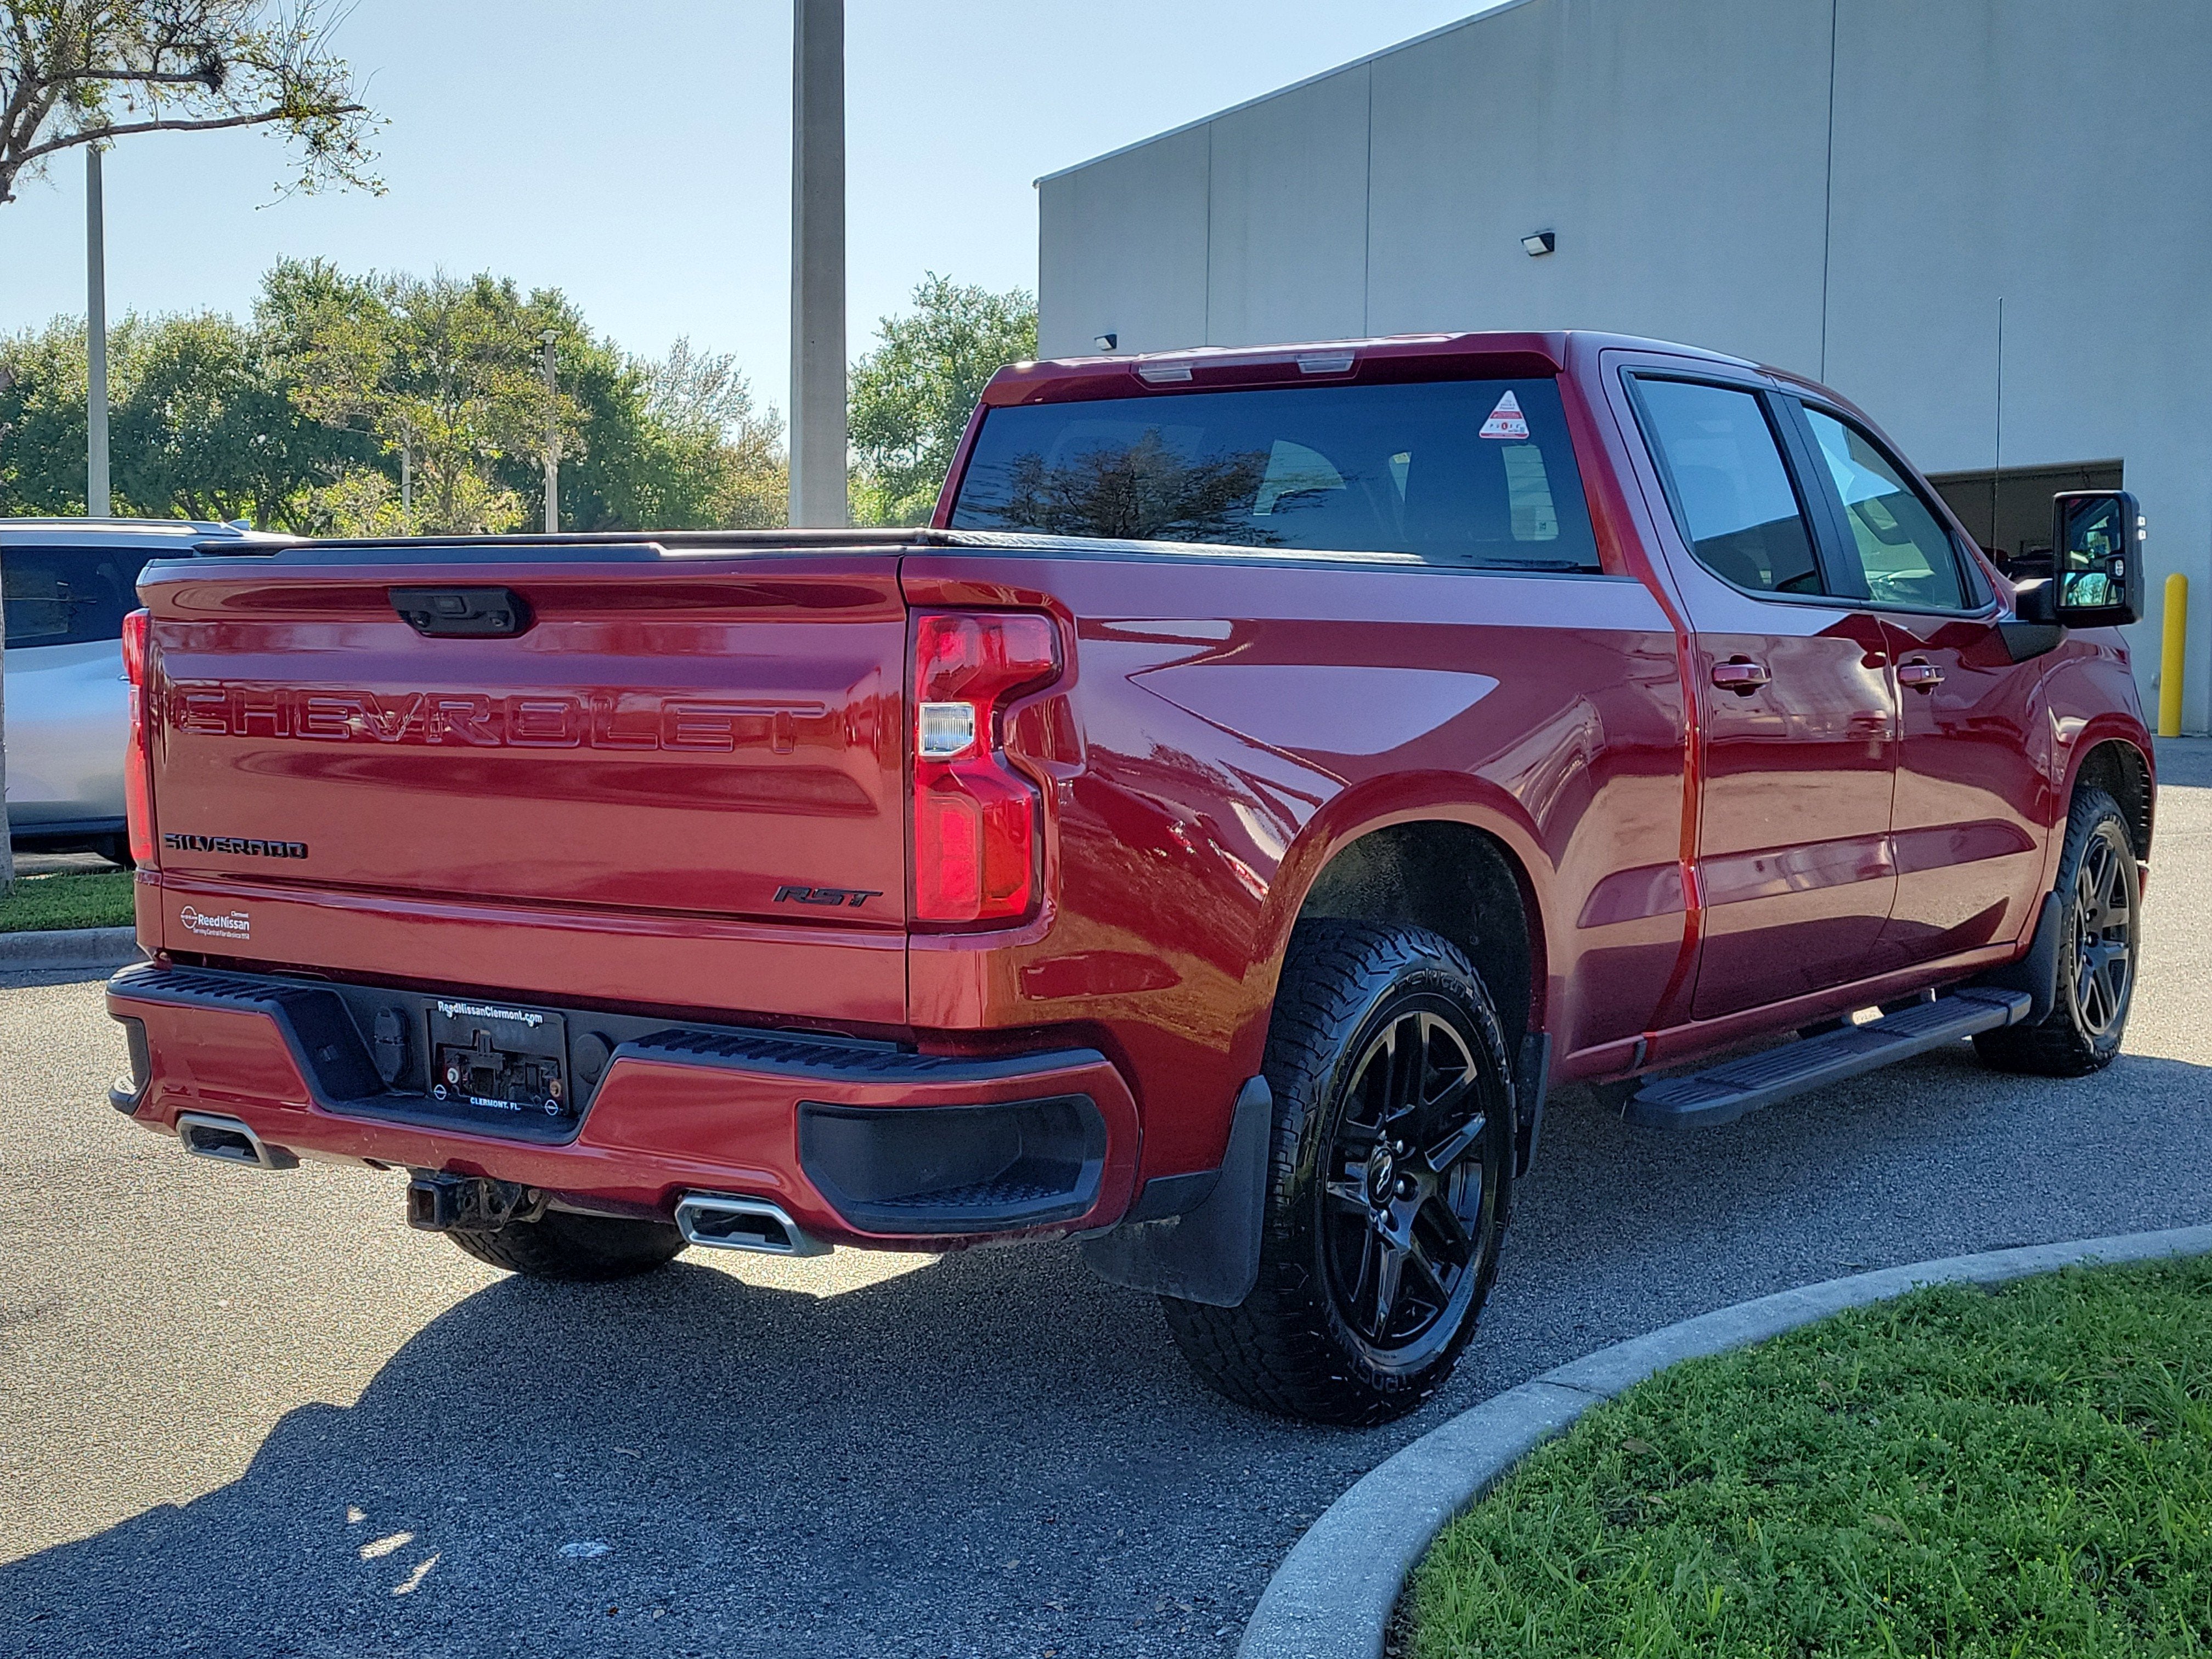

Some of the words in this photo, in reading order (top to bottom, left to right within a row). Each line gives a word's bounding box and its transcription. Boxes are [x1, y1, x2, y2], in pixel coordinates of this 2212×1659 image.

[174, 687, 826, 754] CHEVROLET
[164, 833, 308, 860] SILVERADO
[772, 885, 883, 907] RST
[437, 1001, 543, 1024] ReedNissanClermont.com
